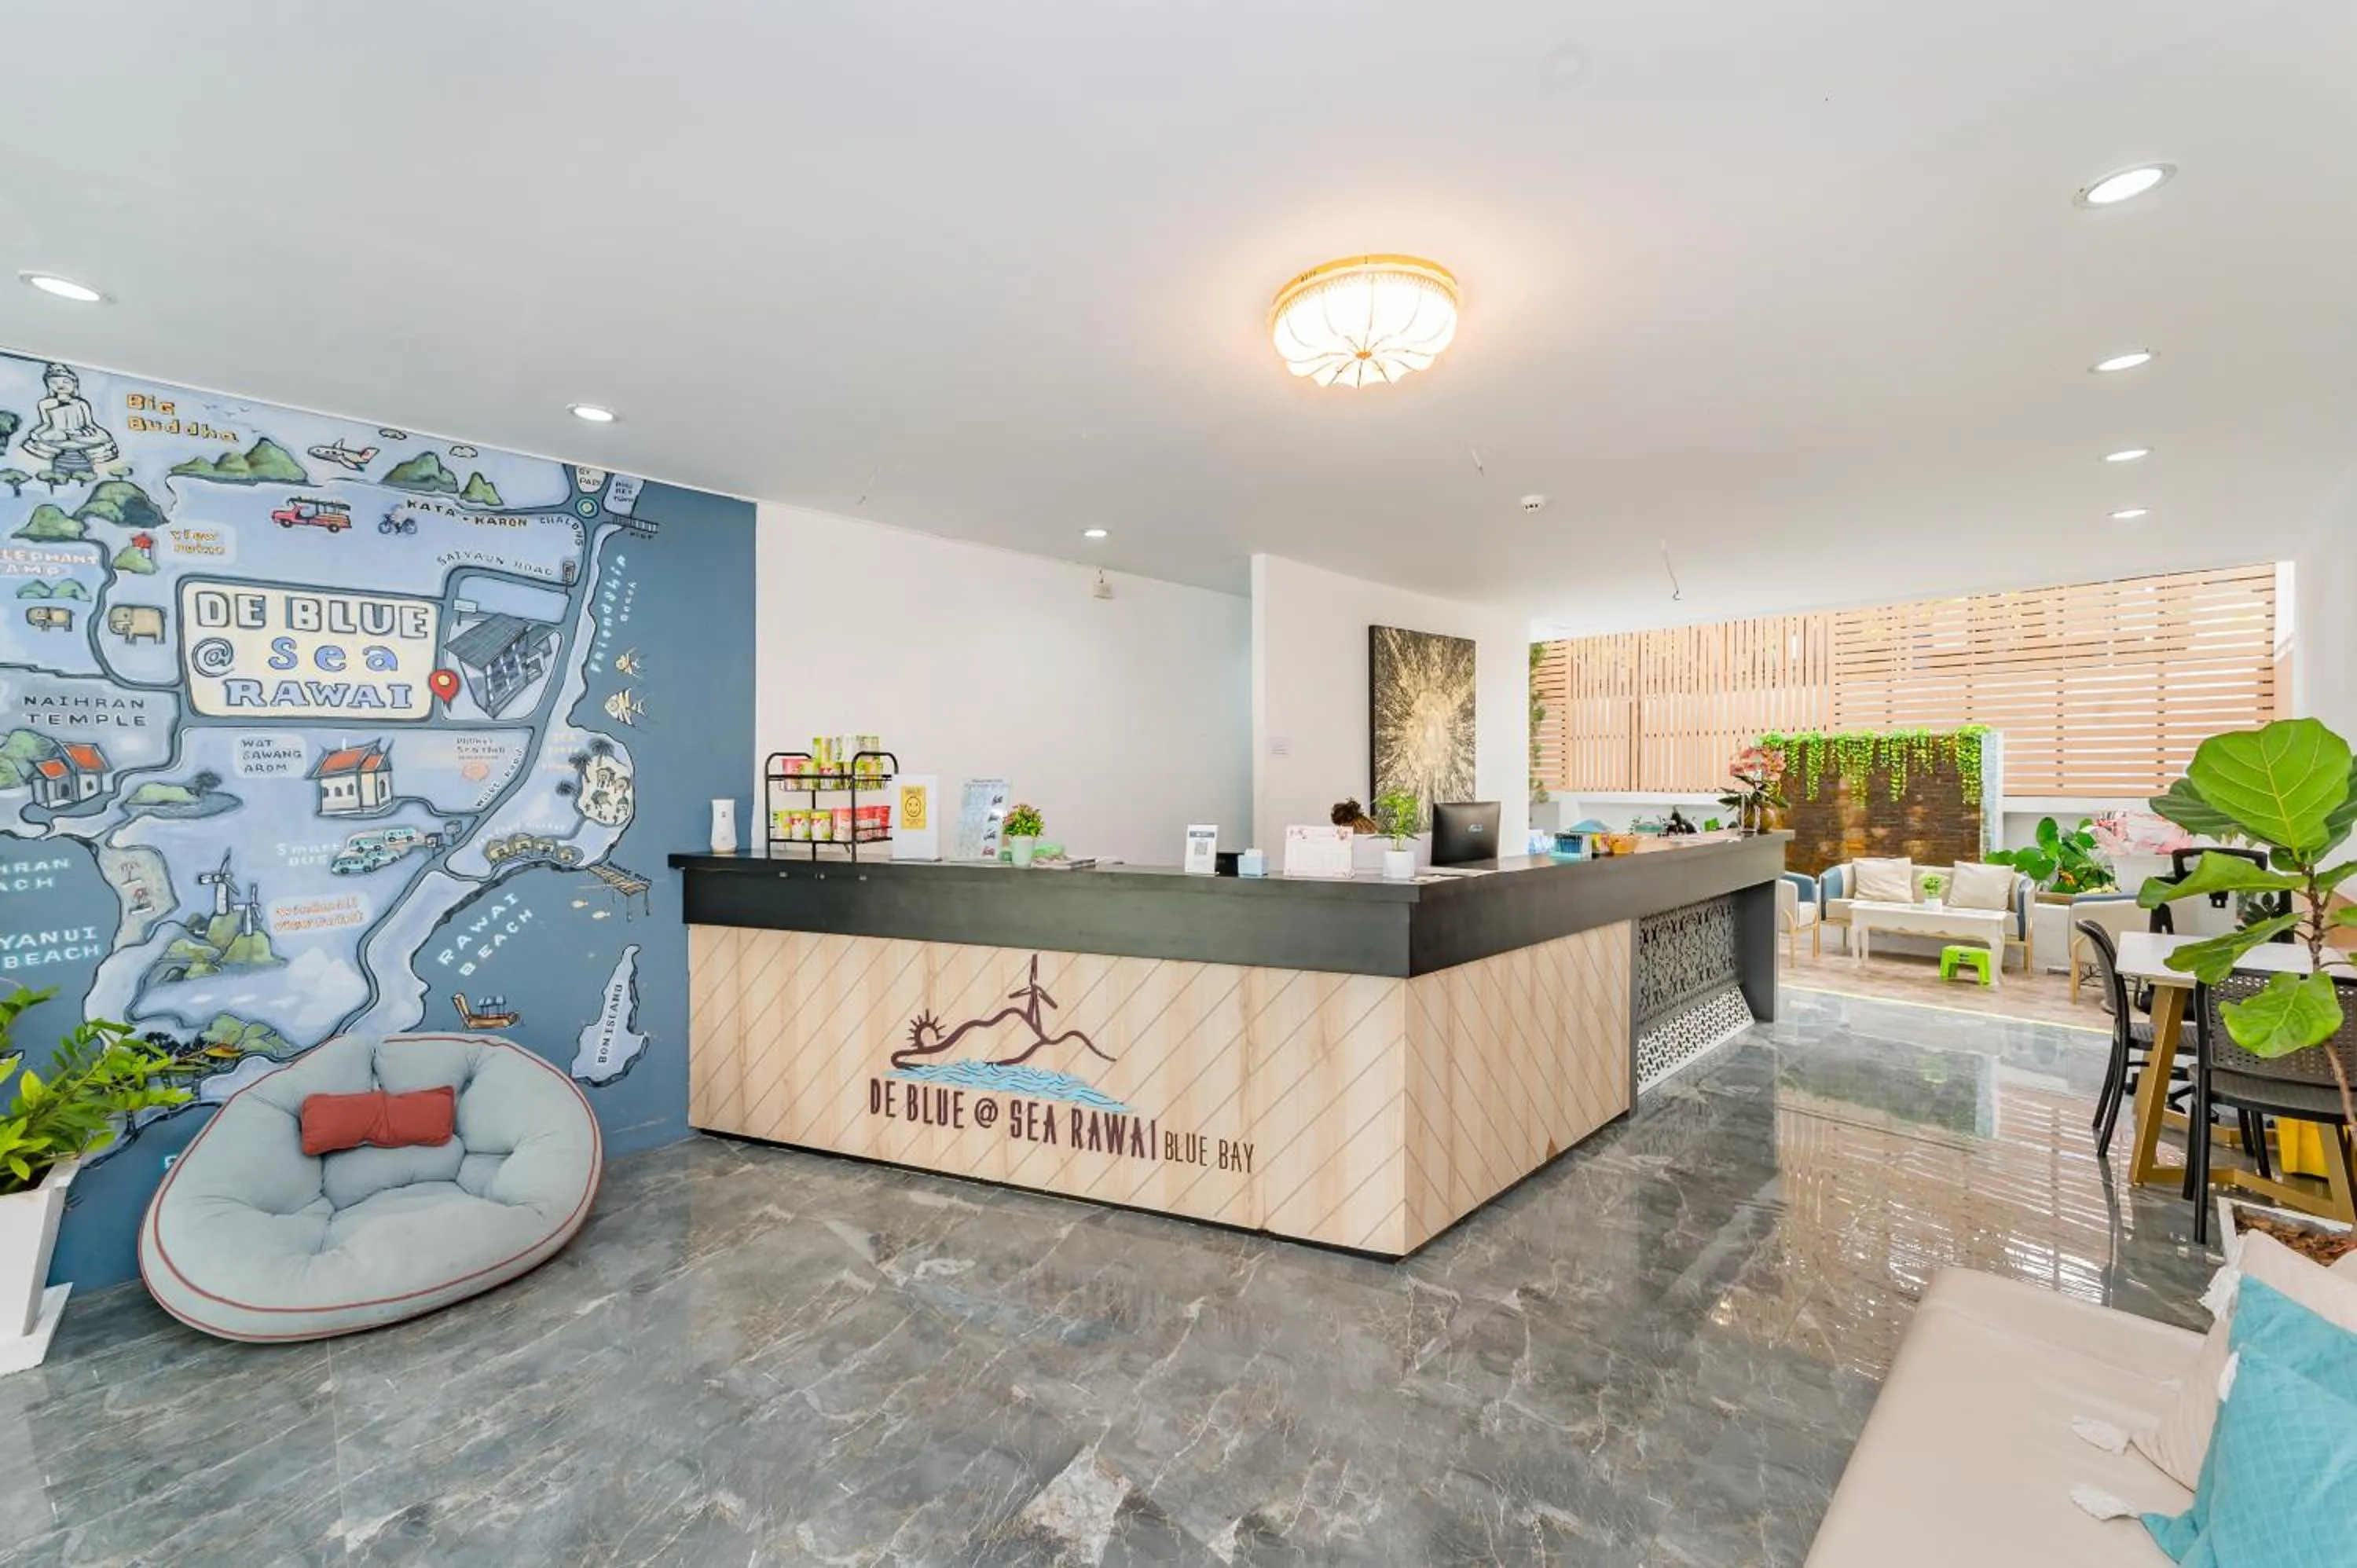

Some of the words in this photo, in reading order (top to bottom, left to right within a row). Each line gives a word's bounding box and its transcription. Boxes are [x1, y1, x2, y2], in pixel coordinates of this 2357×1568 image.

[406, 499, 455, 518] KATA
[475, 515, 527, 527] KARON
[196, 591, 266, 628] DE
[286, 595, 428, 638] BLUE
[192, 637, 234, 677] @
[24, 695, 145, 709] NAIHRAN
[224, 678, 412, 708] RAWAI
[27, 713, 147, 727] TEMPLE
[241, 739, 273, 748] WAT
[242, 750, 302, 760] SAWANG
[244, 763, 287, 773] AROM
[0, 926, 97, 950] YANUI
[437, 892, 518, 965] RAWAI
[459, 909, 533, 976] BEACH
[4, 944, 100, 969] BEACH
[870, 1077, 896, 1118] DE
[907, 1083, 965, 1129] BLUE
[974, 1097, 999, 1129] @
[1010, 1099, 1057, 1145] SEA
[1071, 1108, 1157, 1160] RAWAI
[1164, 1130, 1208, 1167] BLUE
[1219, 1138, 1255, 1174] BAY
